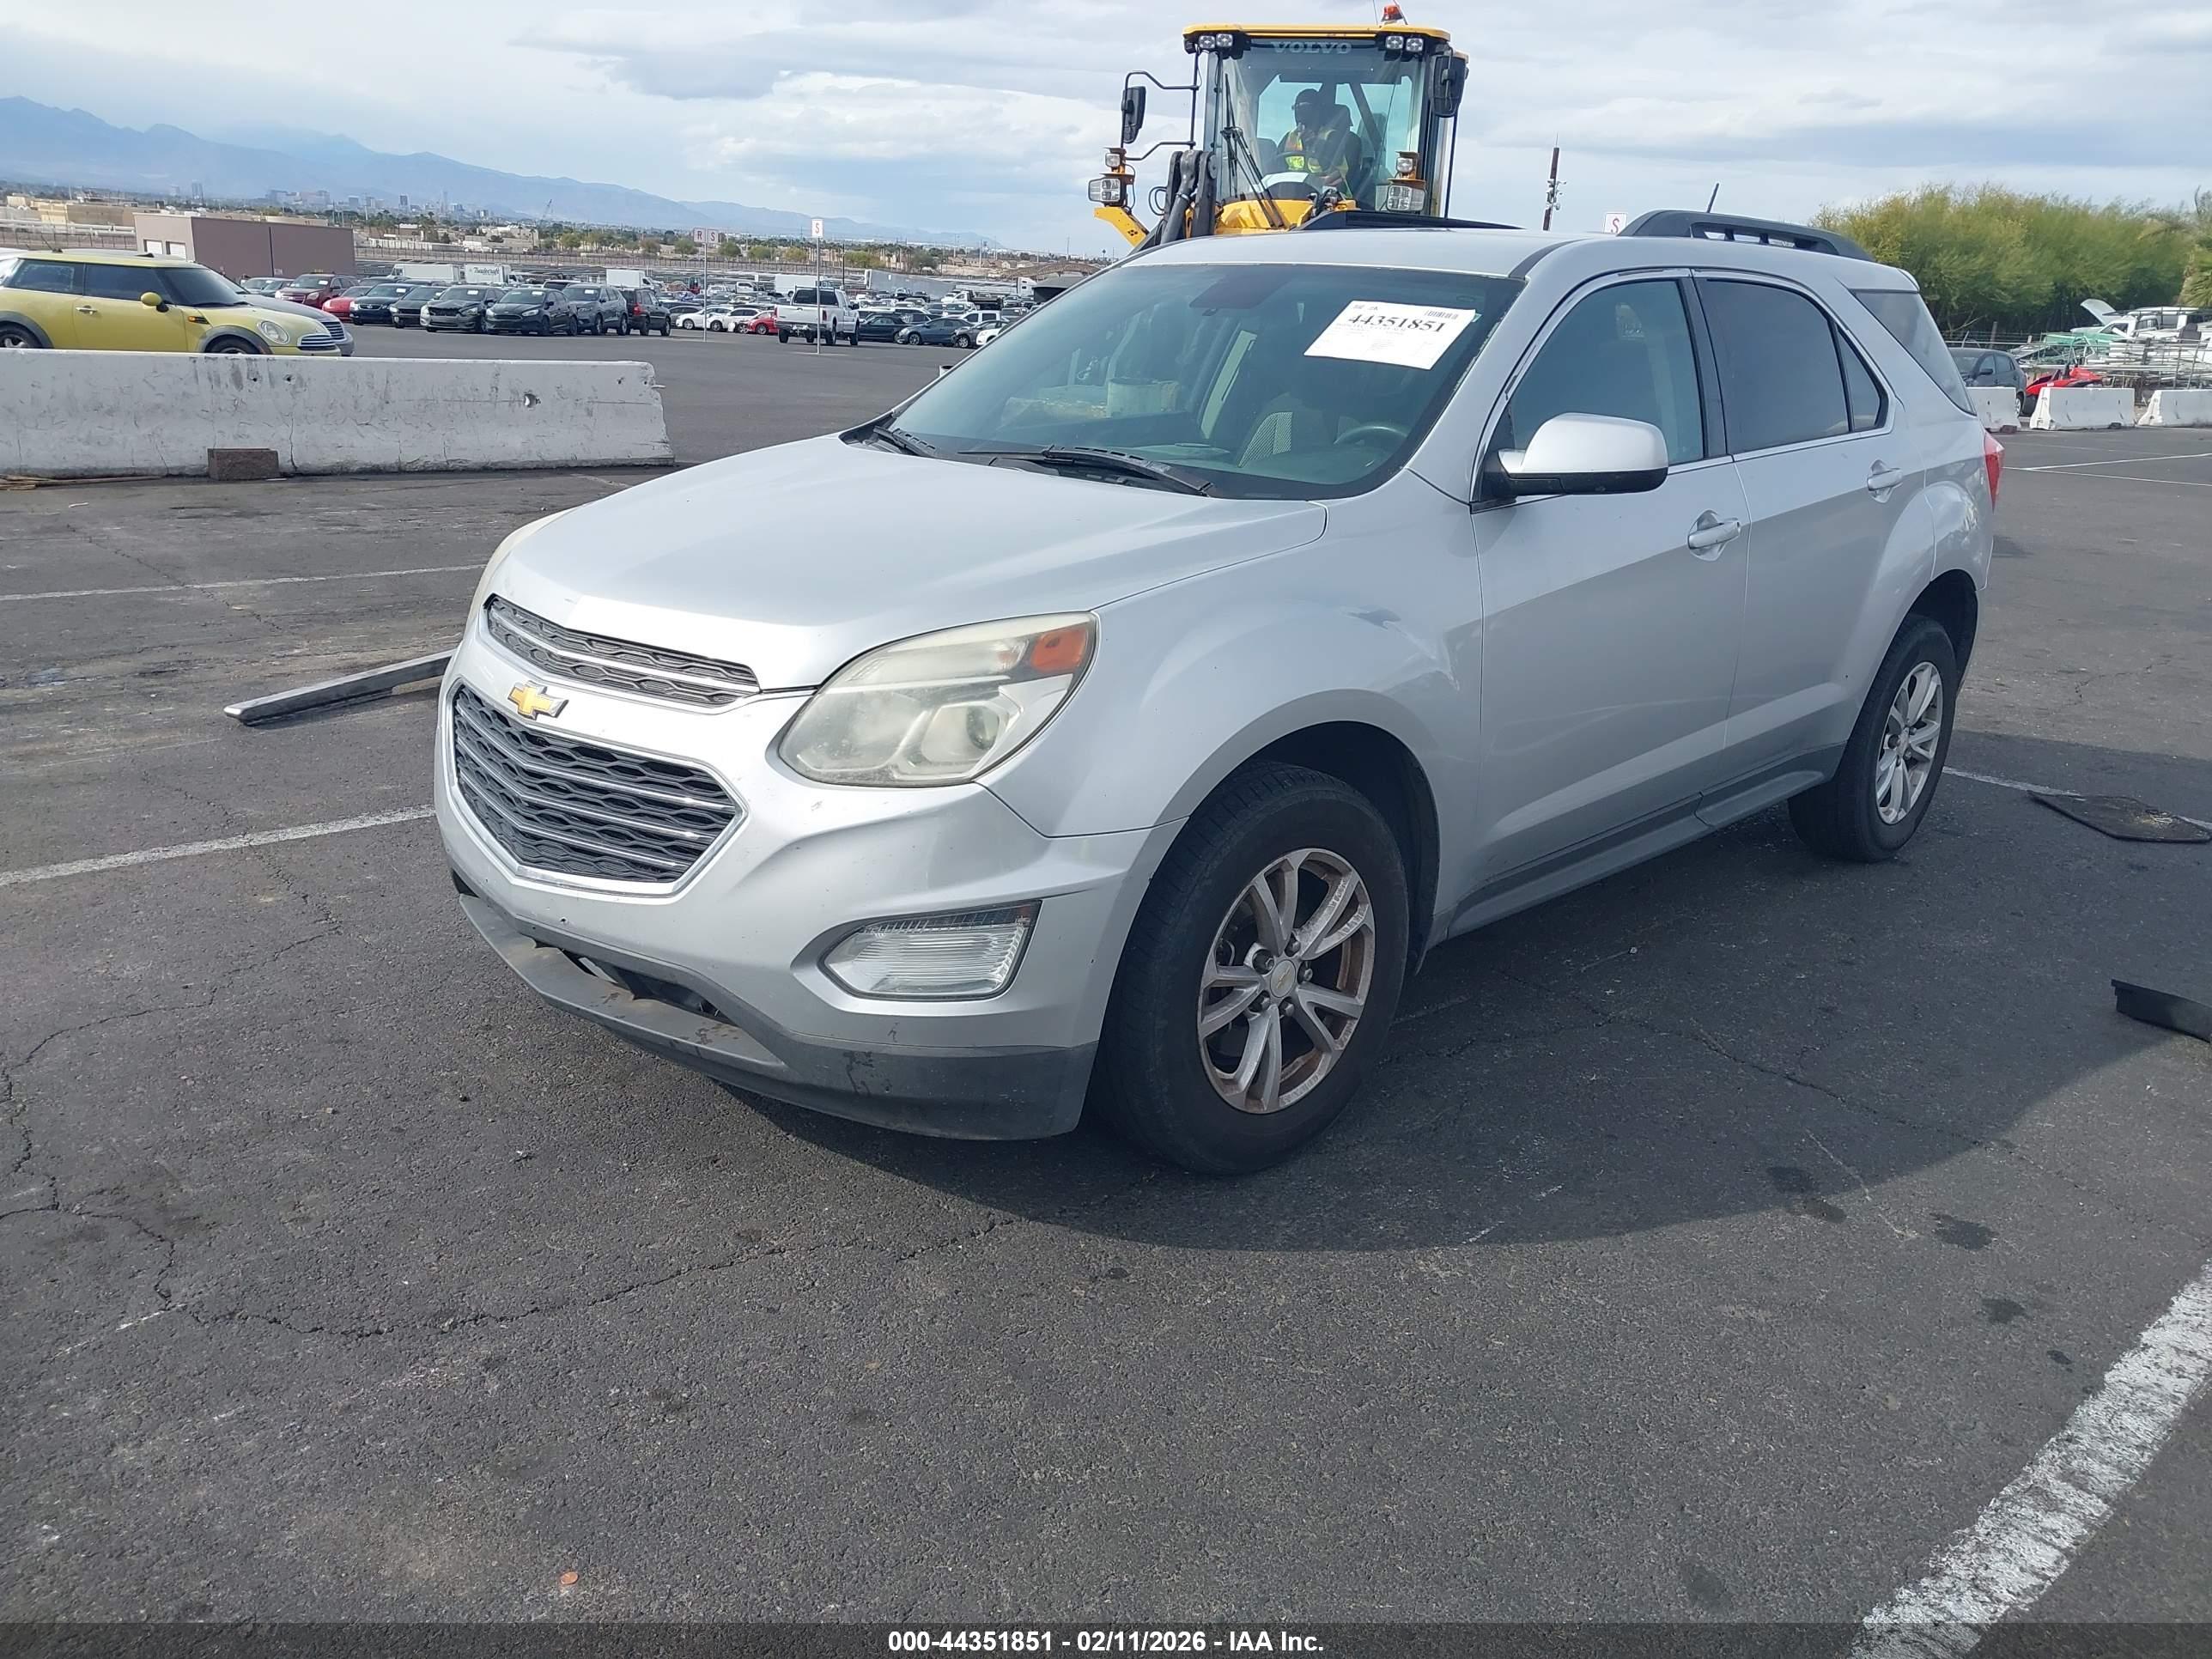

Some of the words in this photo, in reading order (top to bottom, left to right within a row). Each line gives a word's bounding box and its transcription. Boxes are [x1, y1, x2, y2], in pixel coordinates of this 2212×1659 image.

[1270, 41, 1352, 54] VOLVO
[814, 222, 820, 234] S
[696, 230, 702, 240] R
[710, 232, 715, 241] S
[1348, 314, 1446, 332] 44351851
